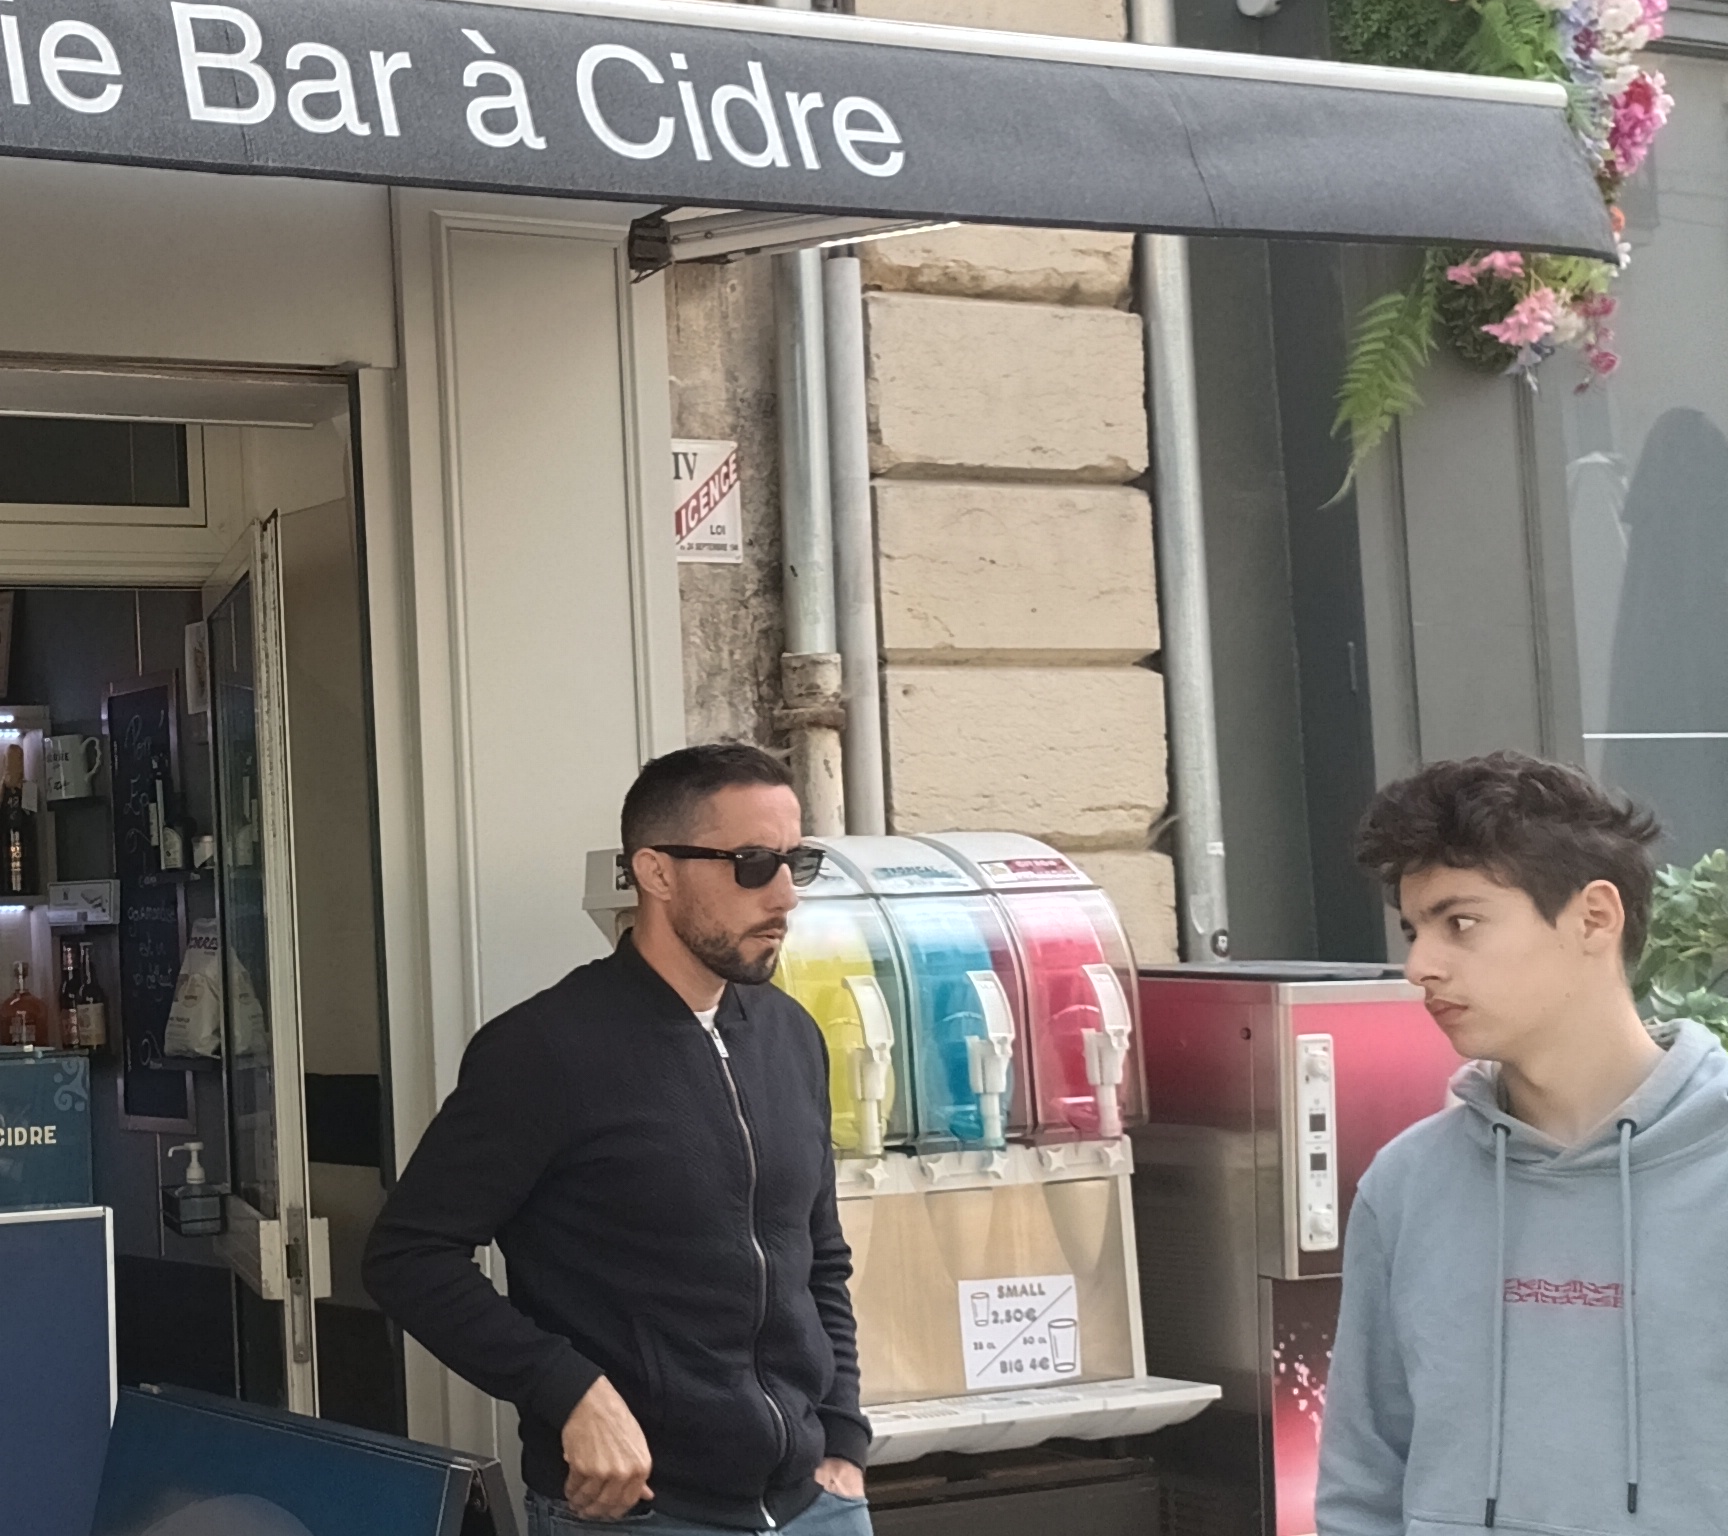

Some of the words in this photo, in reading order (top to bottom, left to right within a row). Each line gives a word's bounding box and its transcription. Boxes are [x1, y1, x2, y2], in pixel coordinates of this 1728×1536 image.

[168, 0, 413, 140] Bar
[463, 27, 545, 150] à
[575, 42, 907, 178] Cidre
[675, 452, 738, 544] ICENCE
[996, 1282, 1046, 1300] SMALL
[999, 1358, 1024, 1375] BIG
[1029, 1356, 1050, 1372] 4€
